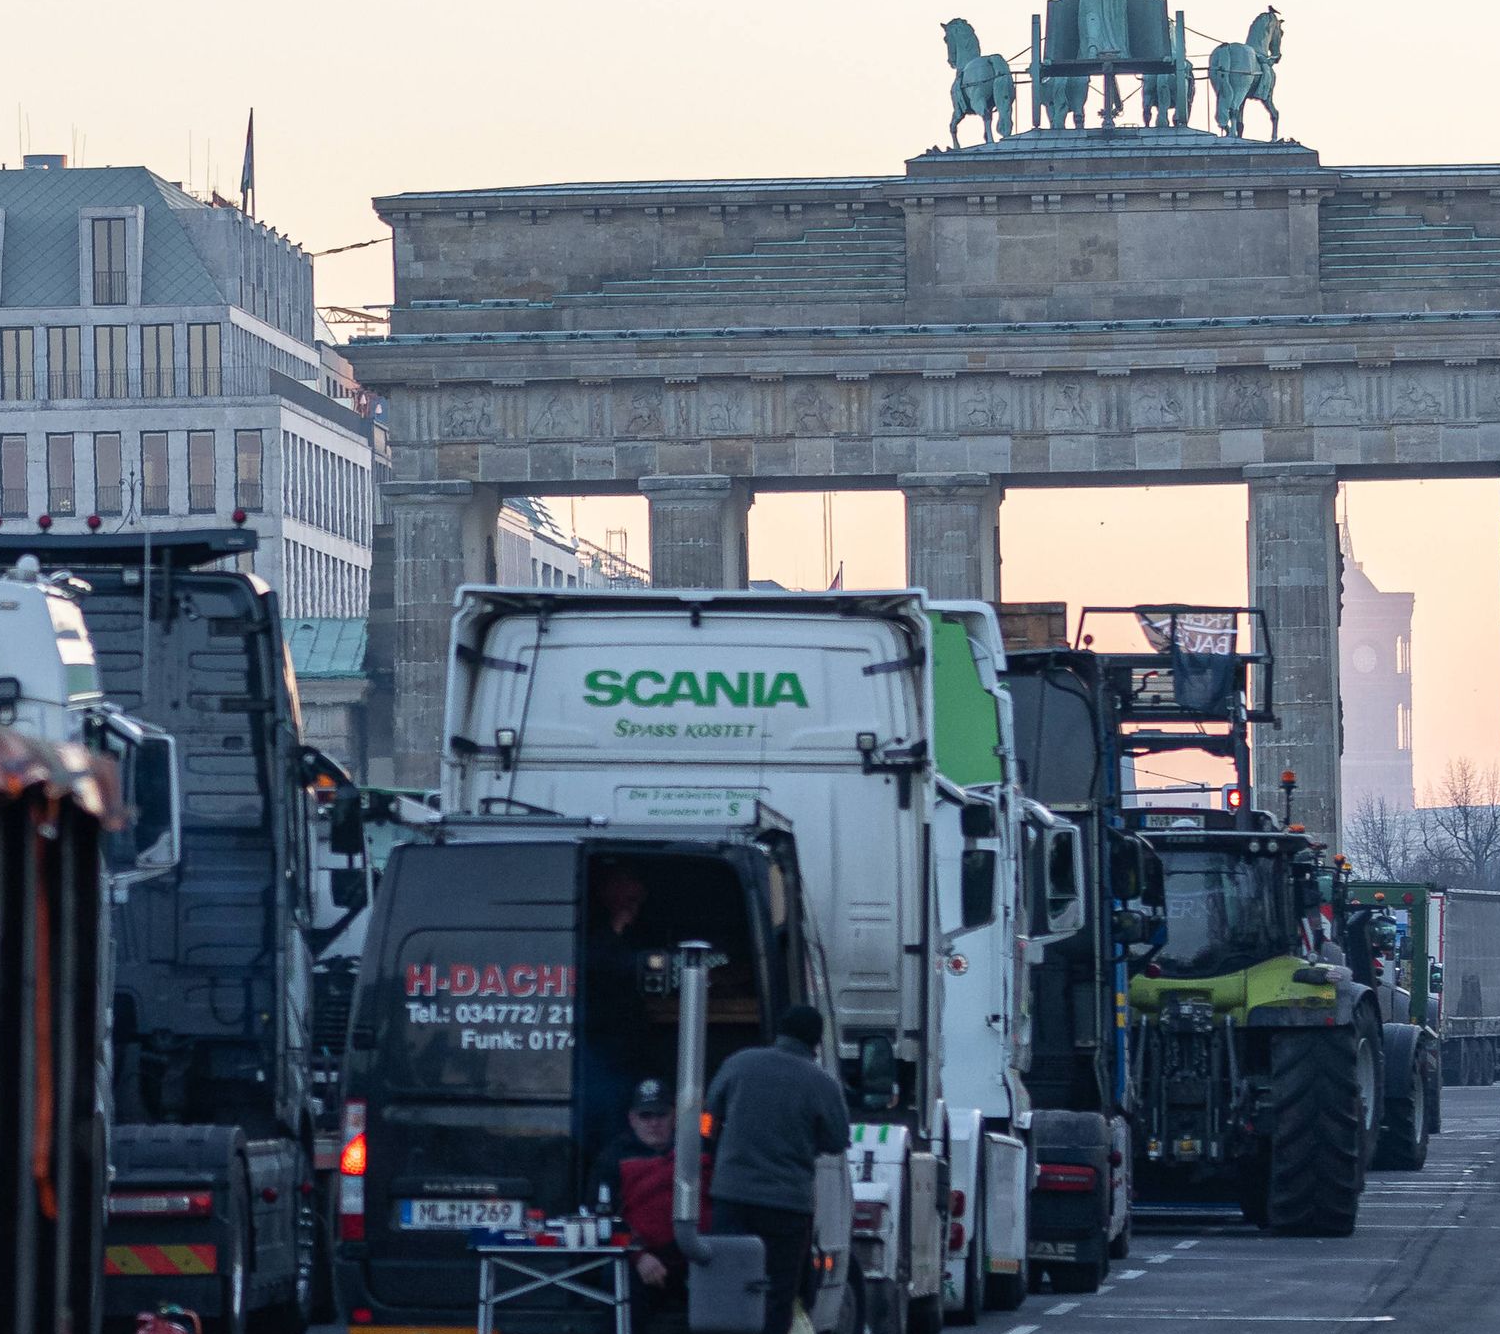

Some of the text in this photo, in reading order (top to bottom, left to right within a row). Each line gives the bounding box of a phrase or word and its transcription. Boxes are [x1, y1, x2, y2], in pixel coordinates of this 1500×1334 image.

[583, 670, 808, 707] SCANIA
[405, 1002, 451, 1023] Tel.:
[461, 1029, 523, 1050] Funk:
[1029, 1241, 1077, 1255] AF
